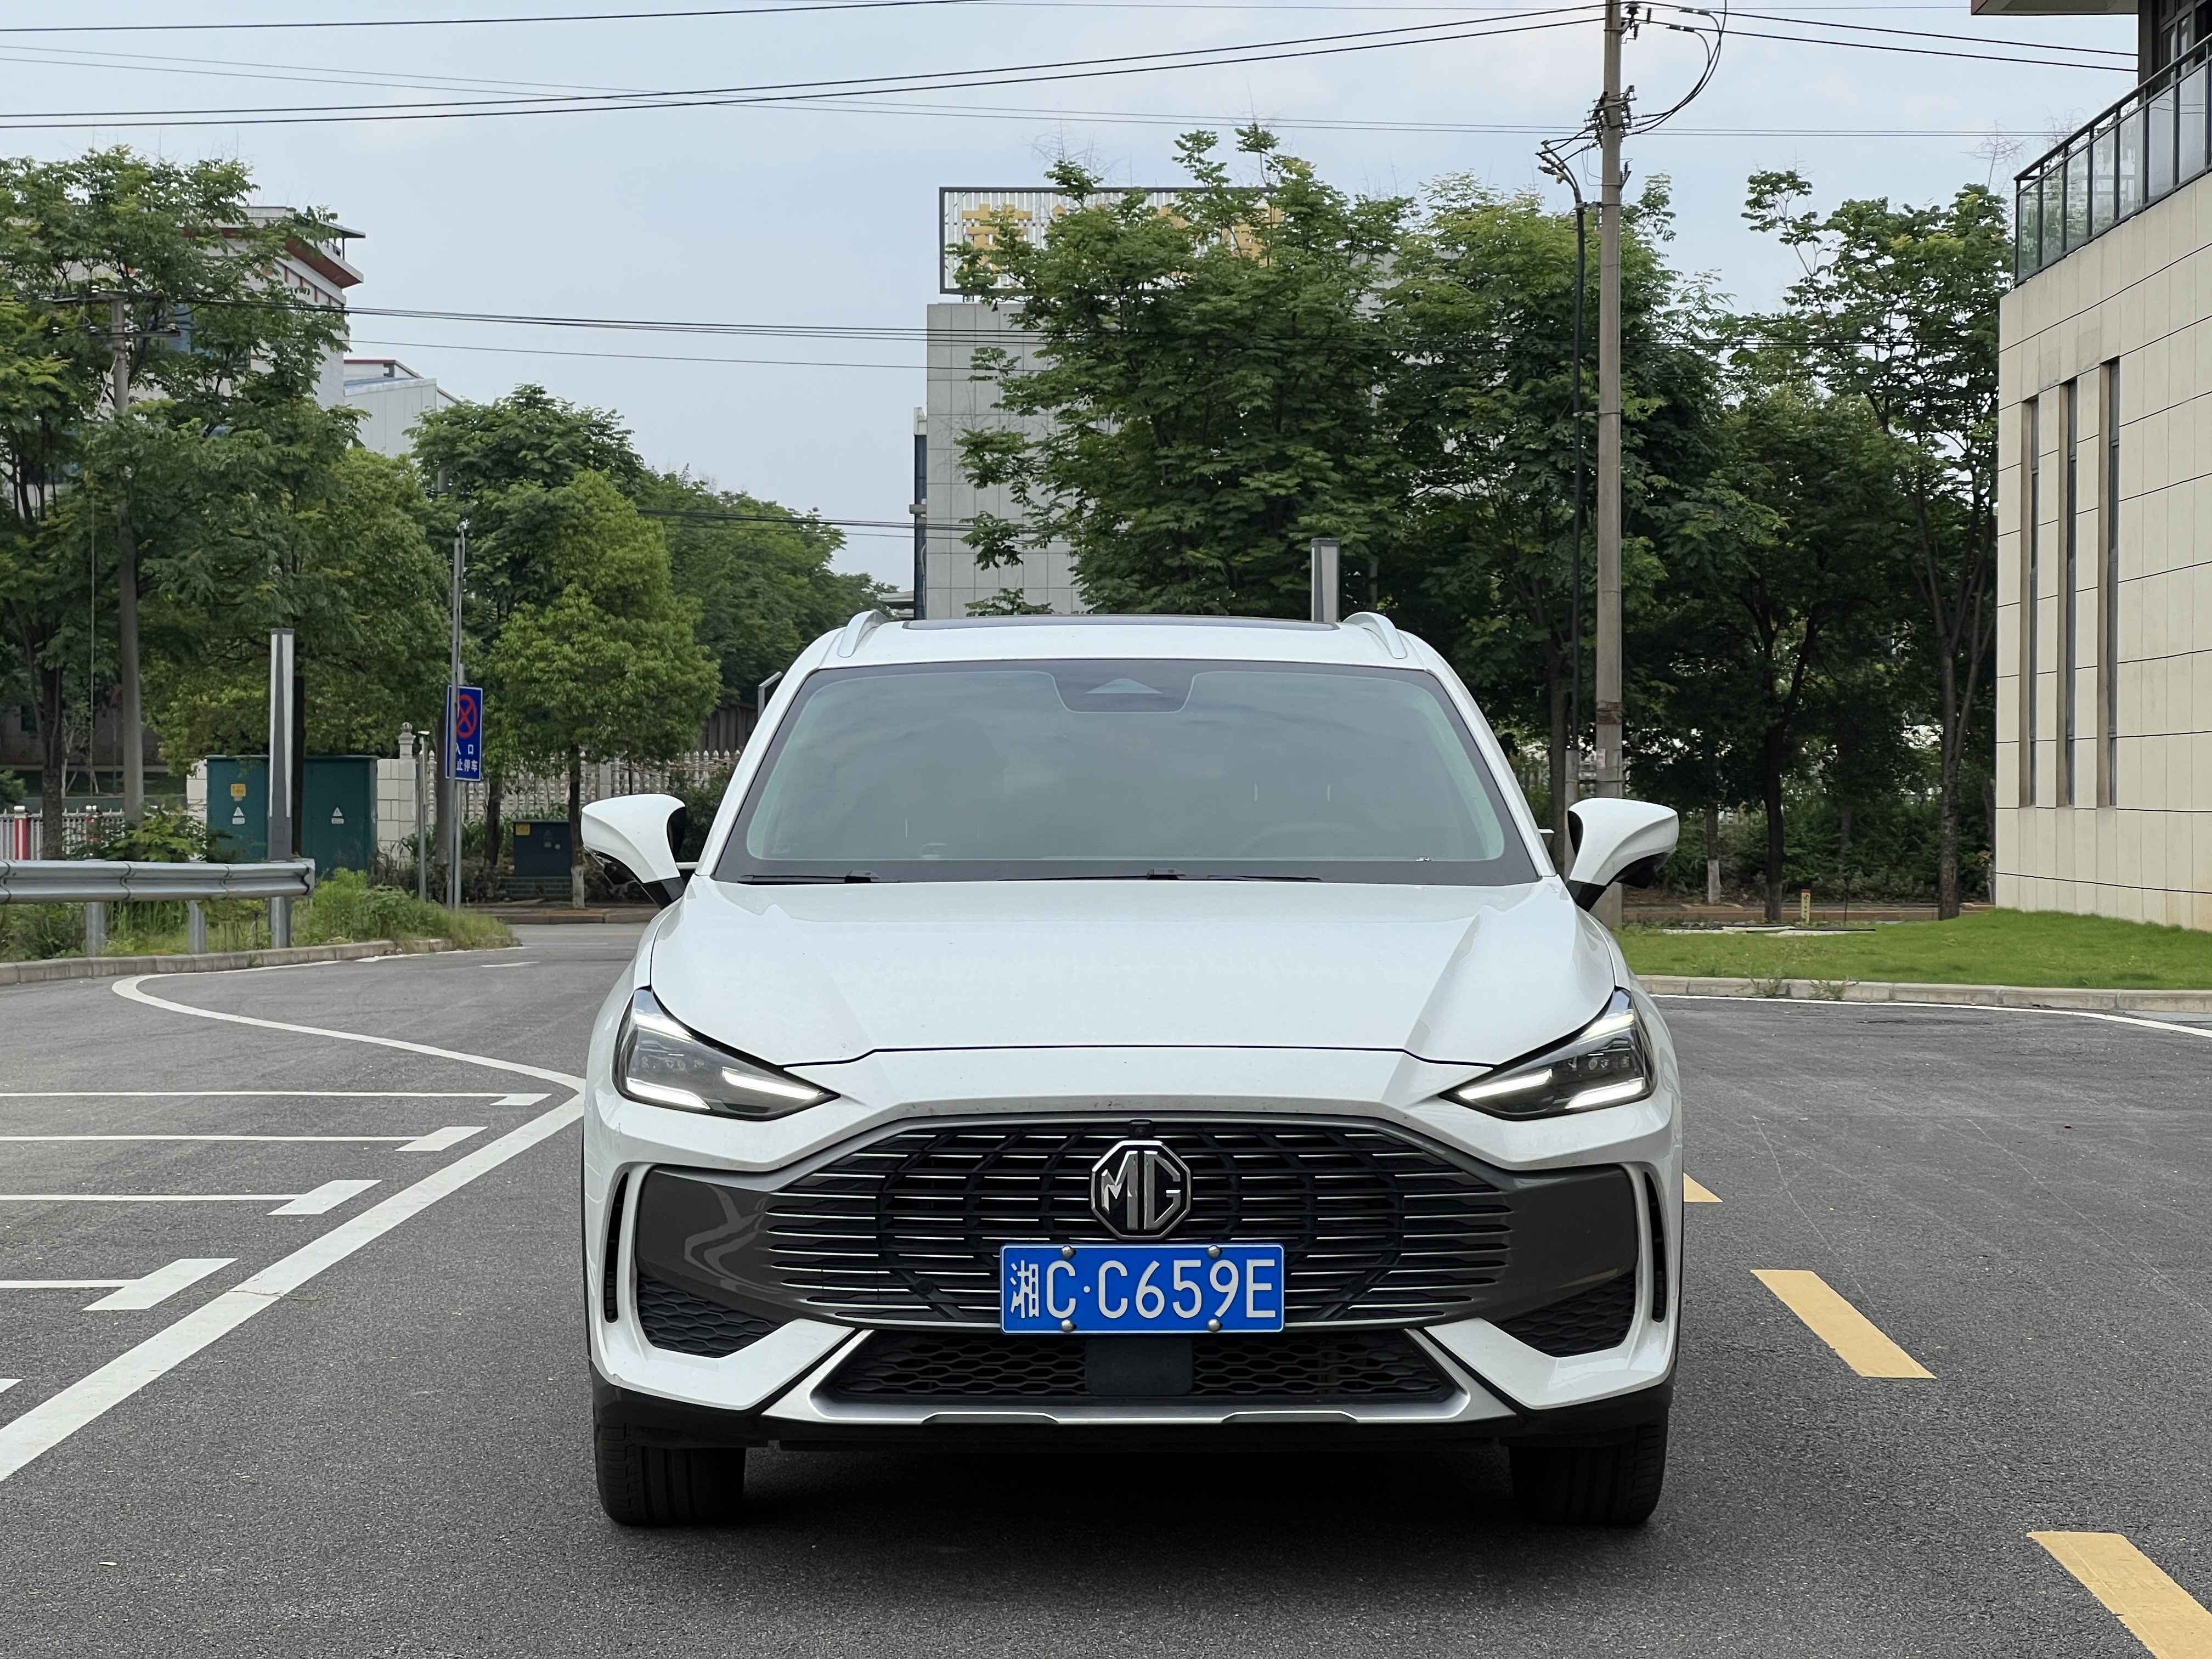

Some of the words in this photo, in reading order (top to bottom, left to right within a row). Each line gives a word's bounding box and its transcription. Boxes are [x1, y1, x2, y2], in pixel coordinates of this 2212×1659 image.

[456, 759, 478, 772] 止停车
[1101, 1150, 1181, 1230] MG
[1009, 1259, 1276, 1319] 湘C·C659E
